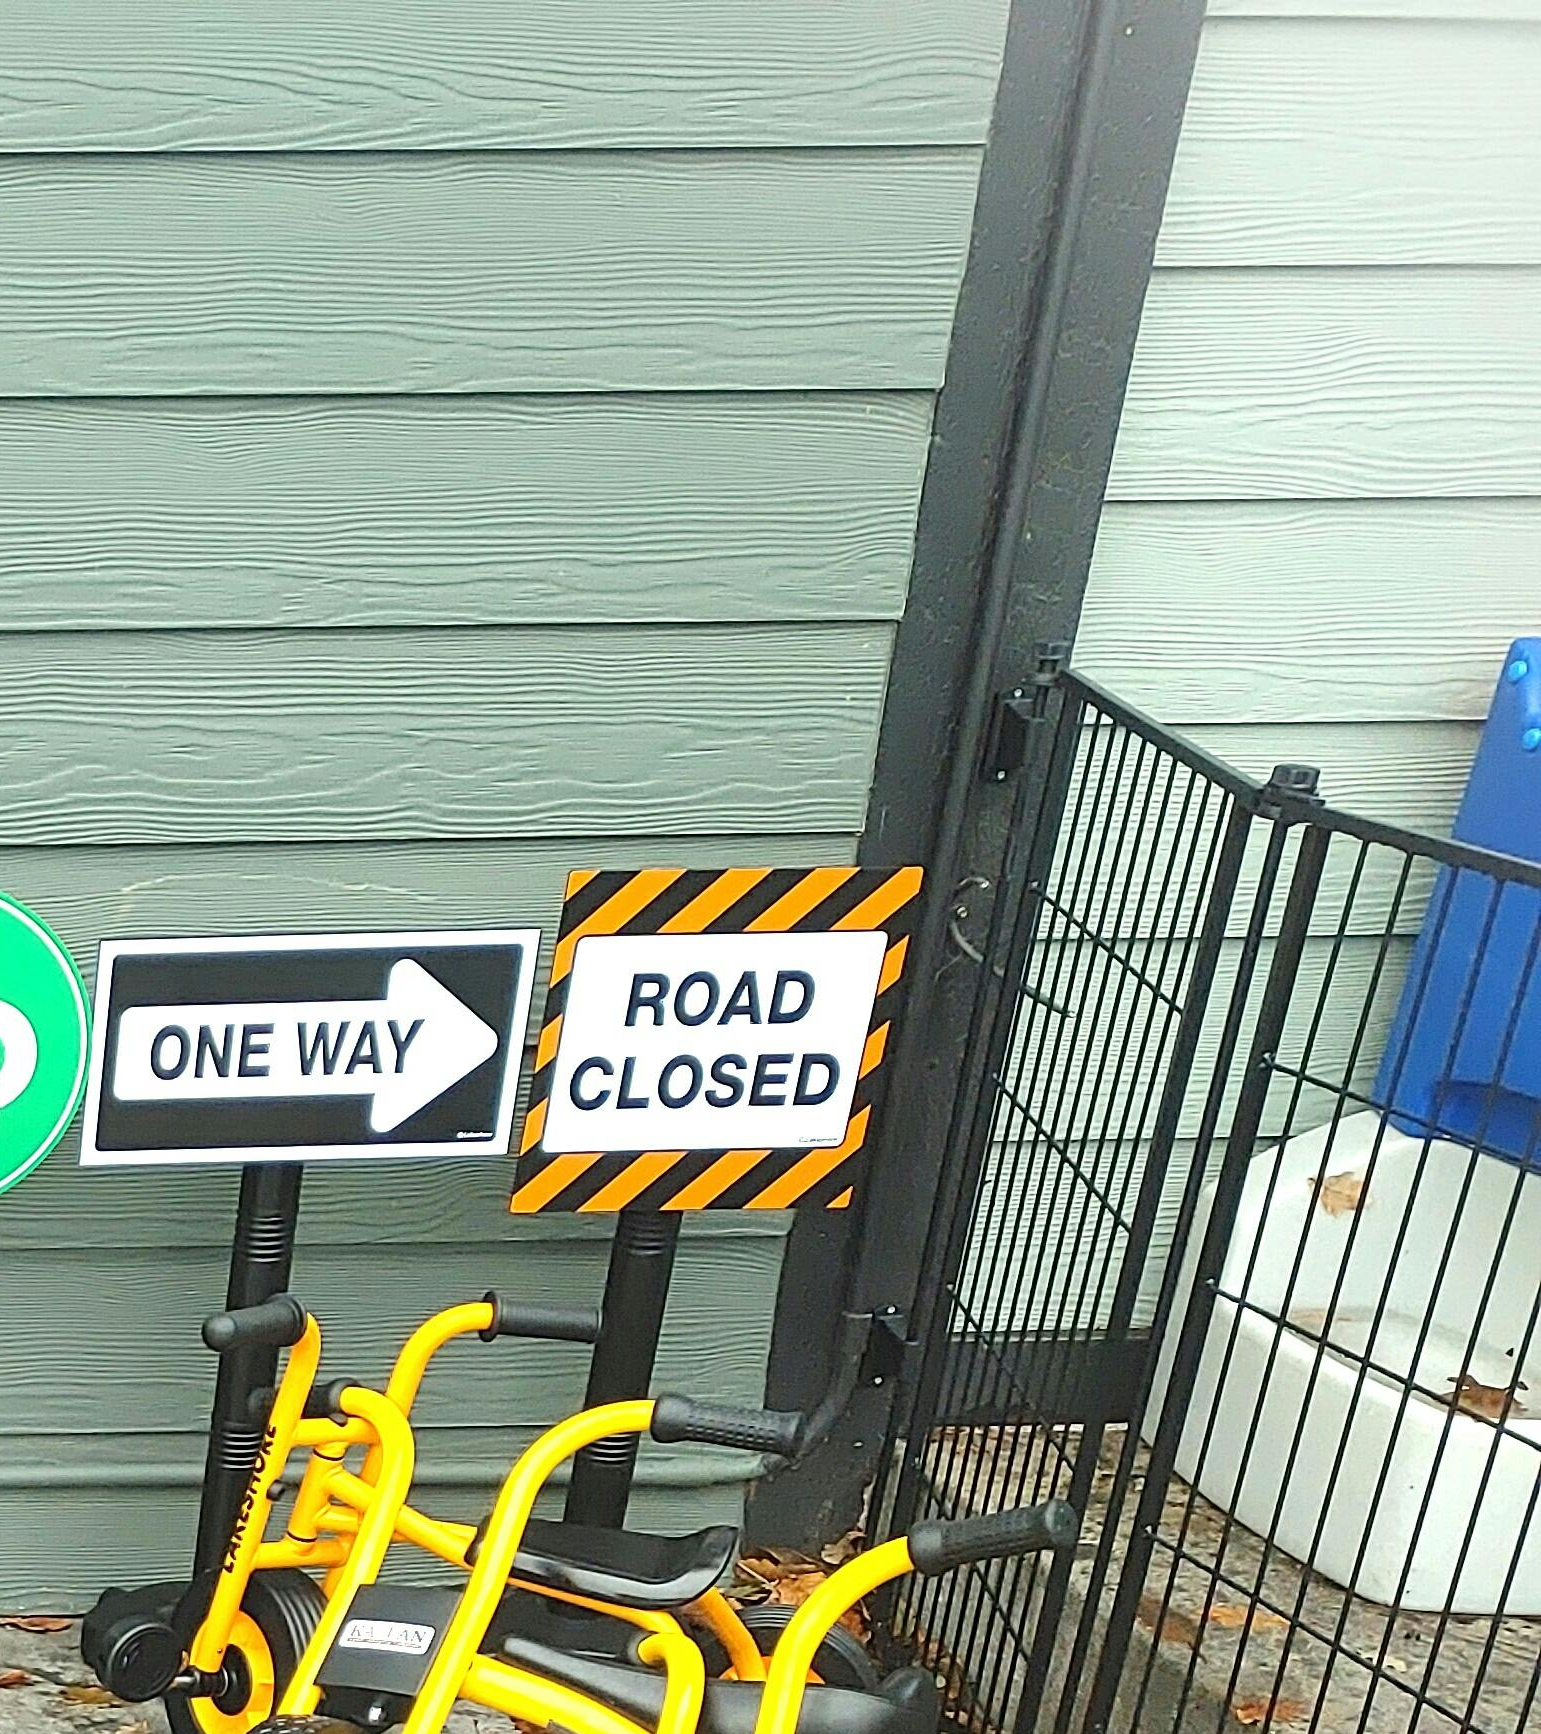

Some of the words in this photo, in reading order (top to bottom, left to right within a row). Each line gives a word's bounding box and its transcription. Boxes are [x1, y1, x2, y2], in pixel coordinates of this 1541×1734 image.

[624, 970, 815, 1027] ROAD
[150, 1024, 274, 1081] ONE
[296, 1019, 425, 1076] WAY
[569, 1053, 839, 1111] CLOSED
